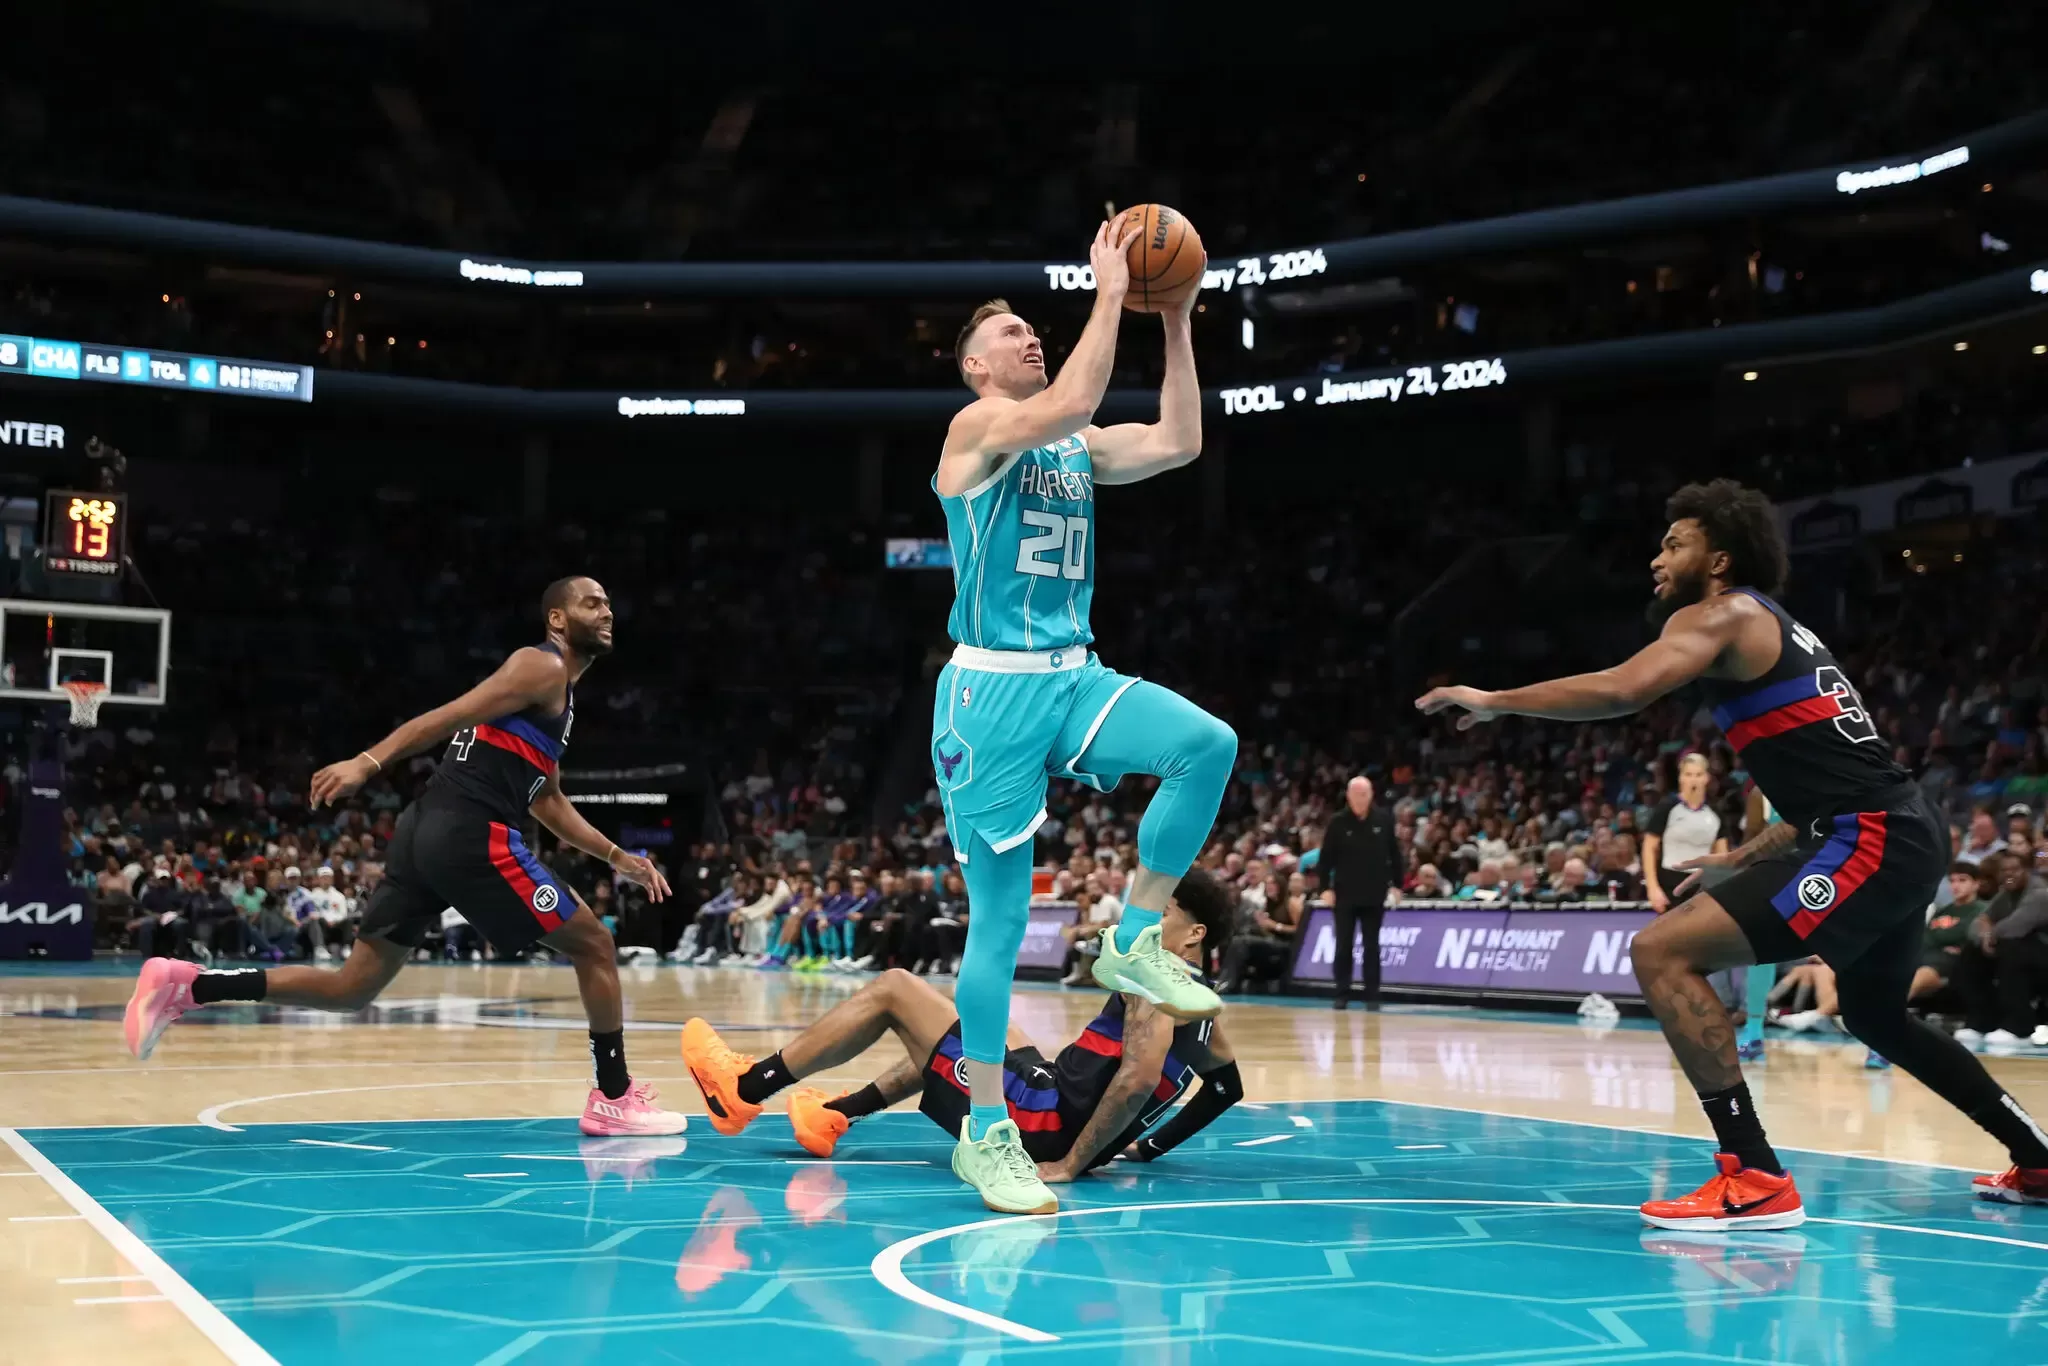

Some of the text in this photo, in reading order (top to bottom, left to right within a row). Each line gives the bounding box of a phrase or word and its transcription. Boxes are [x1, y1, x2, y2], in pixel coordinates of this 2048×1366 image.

[1044, 265, 1097, 290] TOO
[1268, 248, 1328, 280] 2024
[33, 345, 79, 371] CHA
[86, 353, 119, 374] FLS
[150, 360, 187, 381] TOL
[1220, 385, 1285, 415] TOOL
[1315, 378, 1404, 405] January
[1442, 358, 1507, 391] 2024
[0, 419, 65, 449] NTER
[1019, 464, 1093, 502] HORETS
[74, 521, 109, 558] 13
[1015, 508, 1089, 580] 20
[1486, 928, 1566, 951] NOVANT
[1479, 950, 1551, 972] HEALTH
